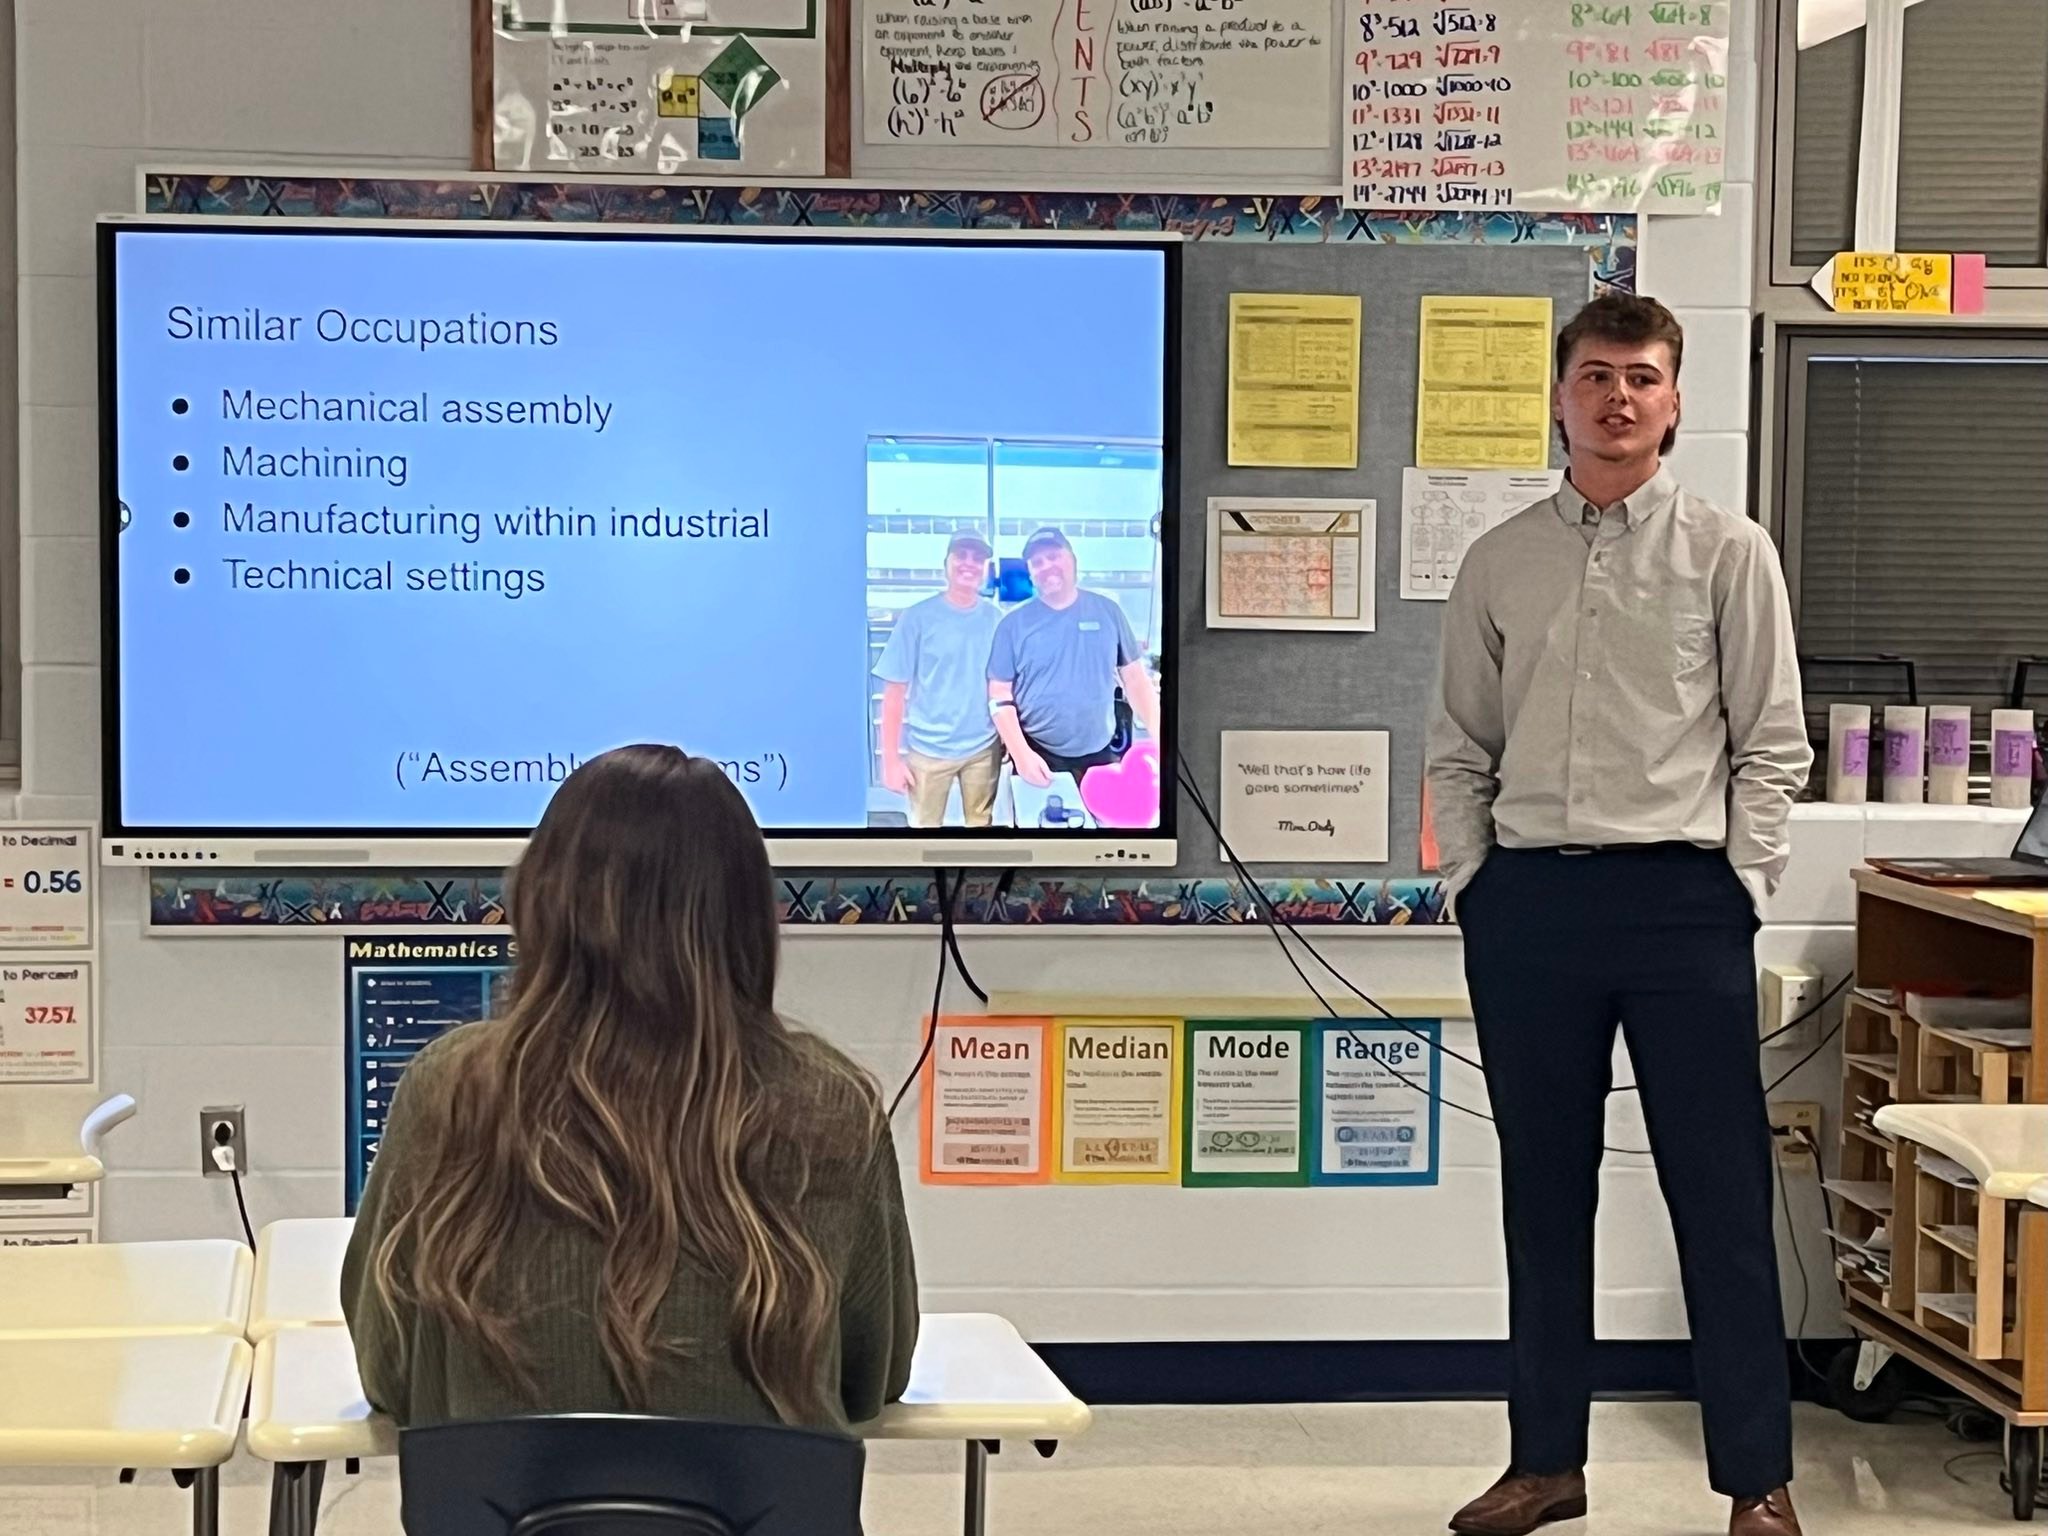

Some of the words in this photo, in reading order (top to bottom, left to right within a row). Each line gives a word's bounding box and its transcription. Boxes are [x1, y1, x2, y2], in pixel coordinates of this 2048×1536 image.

[167, 306, 302, 341] Similar
[316, 309, 559, 352] Occupations
[222, 389, 428, 422] Mechanical
[442, 394, 613, 433] assembly
[223, 446, 407, 487] Machining
[223, 502, 480, 543] Manufacturing
[494, 506, 597, 536] within
[611, 507, 769, 538] industrial
[222, 559, 392, 590] Technical
[406, 561, 546, 600] settings
[1317, 764, 1346, 776] how
[1349, 764, 1371, 777] life
[21, 835, 77, 847] Decimal
[24, 869, 82, 894] 0.56
[350, 940, 499, 959] Mathematics
[22, 969, 79, 981] Percent
[951, 1036, 1030, 1060] Mean
[1068, 1035, 1169, 1060] Median
[1208, 1034, 1290, 1059] Mode
[1335, 1036, 1420, 1065] Range
